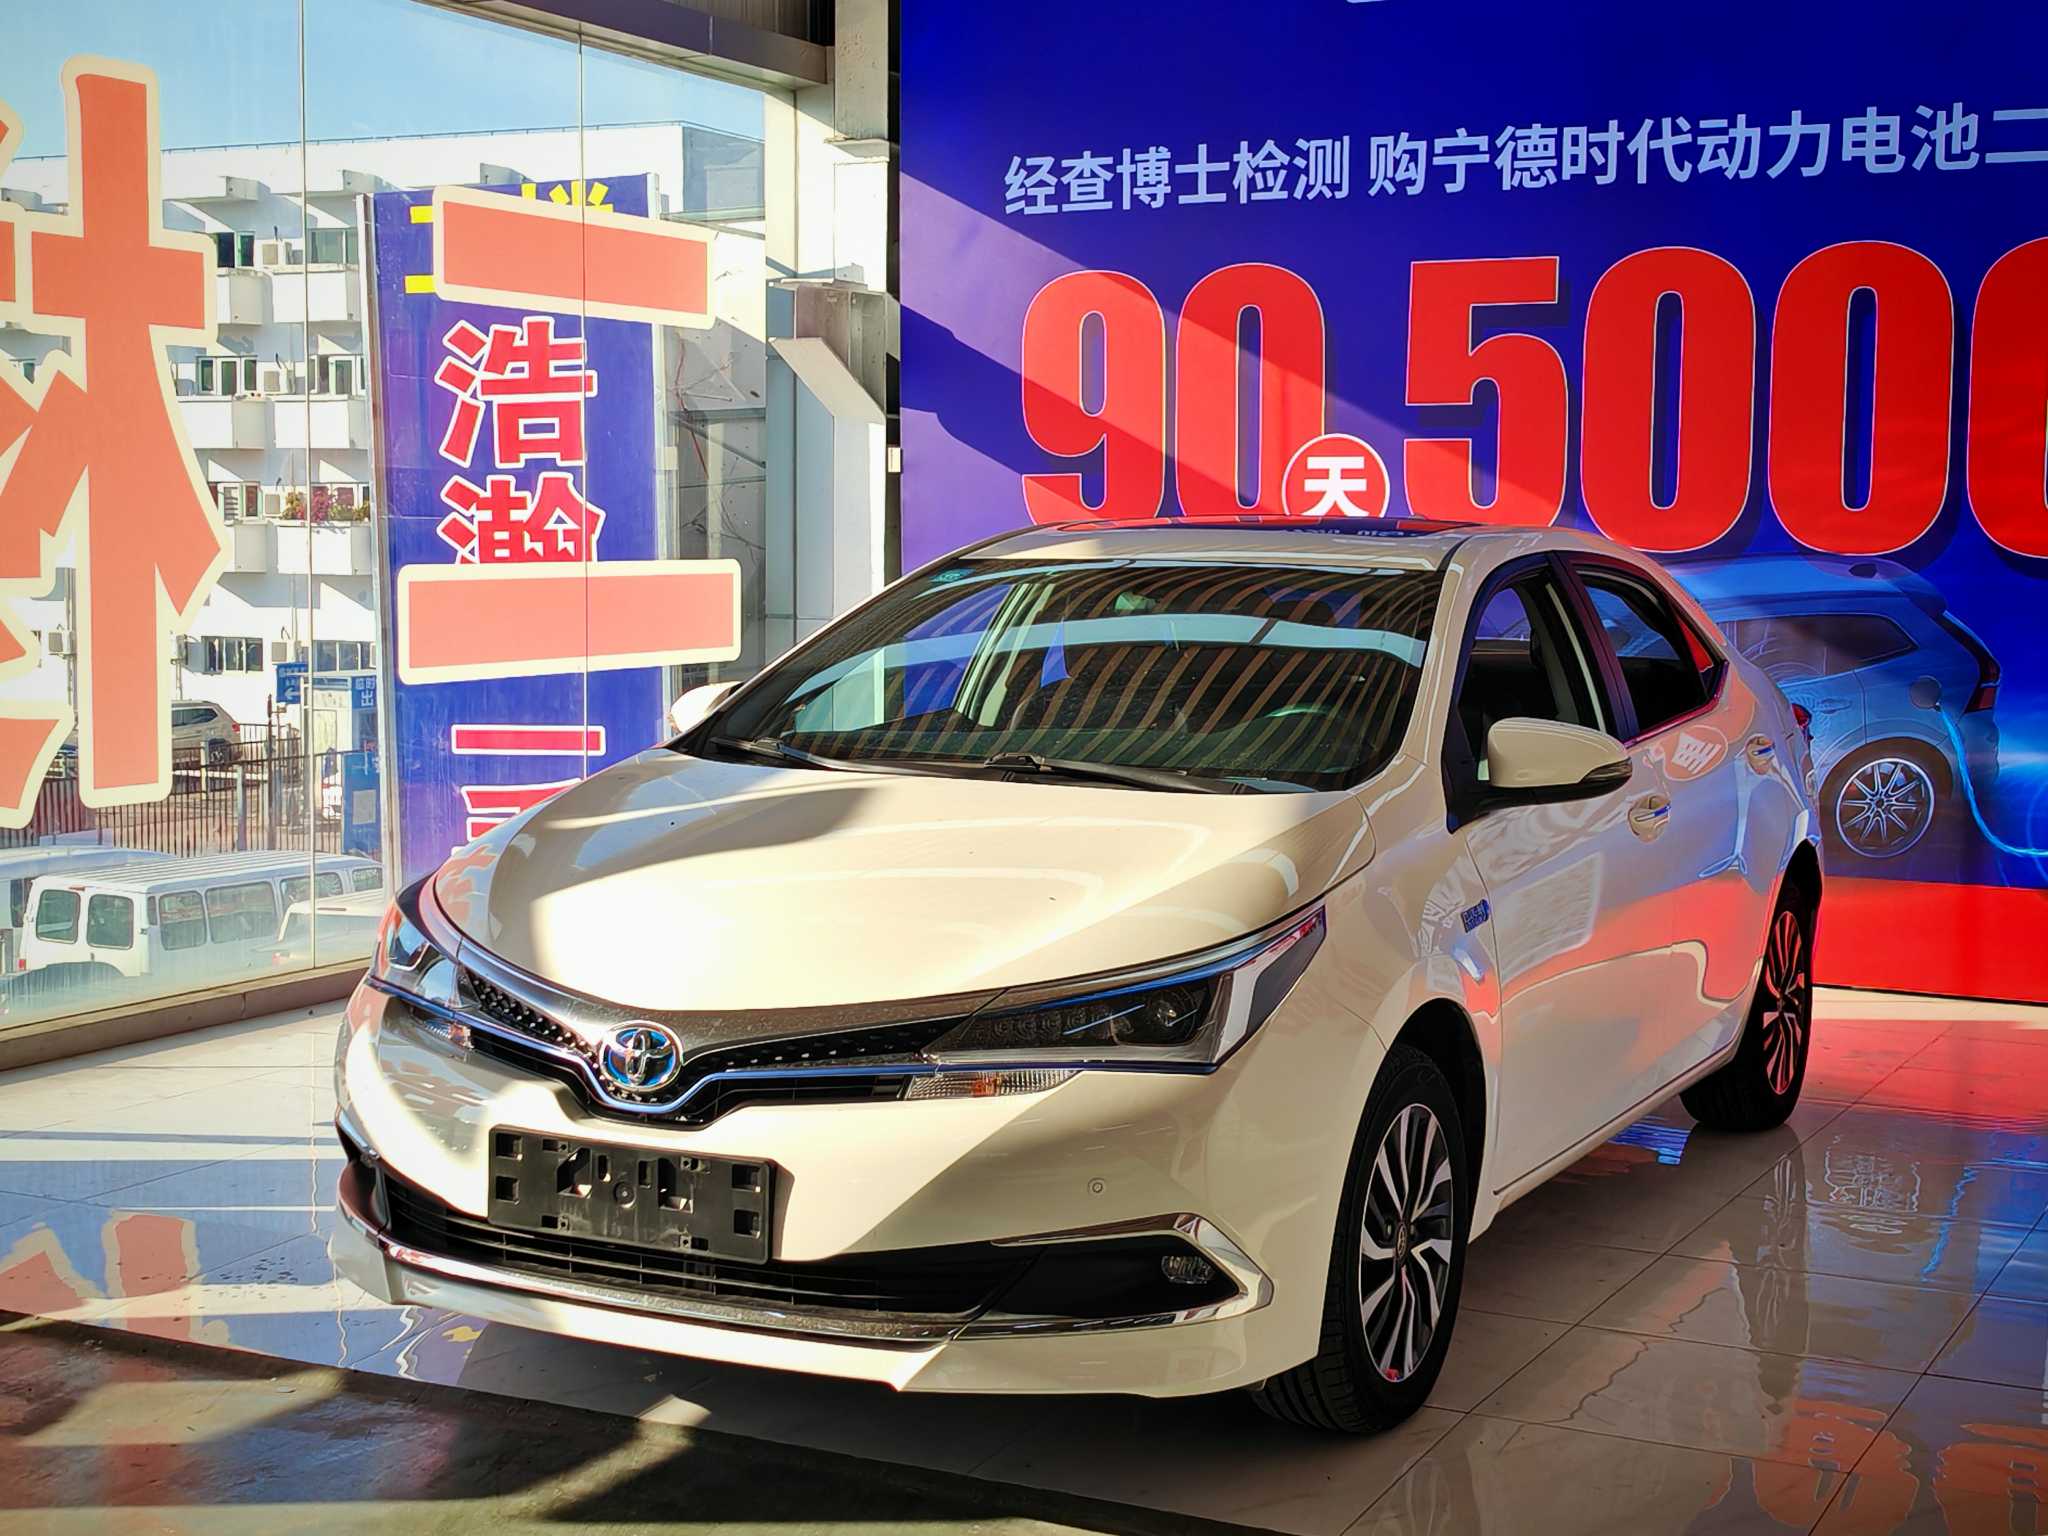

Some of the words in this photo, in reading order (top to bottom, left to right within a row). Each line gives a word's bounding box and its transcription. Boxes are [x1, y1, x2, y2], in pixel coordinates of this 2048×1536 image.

[1004, 136, 1351, 215] 经查博士检测
[1367, 102, 2048, 197] 购宁德时代动力电池二
[1021, 262, 1327, 528] 90
[1303, 455, 1370, 517] 天
